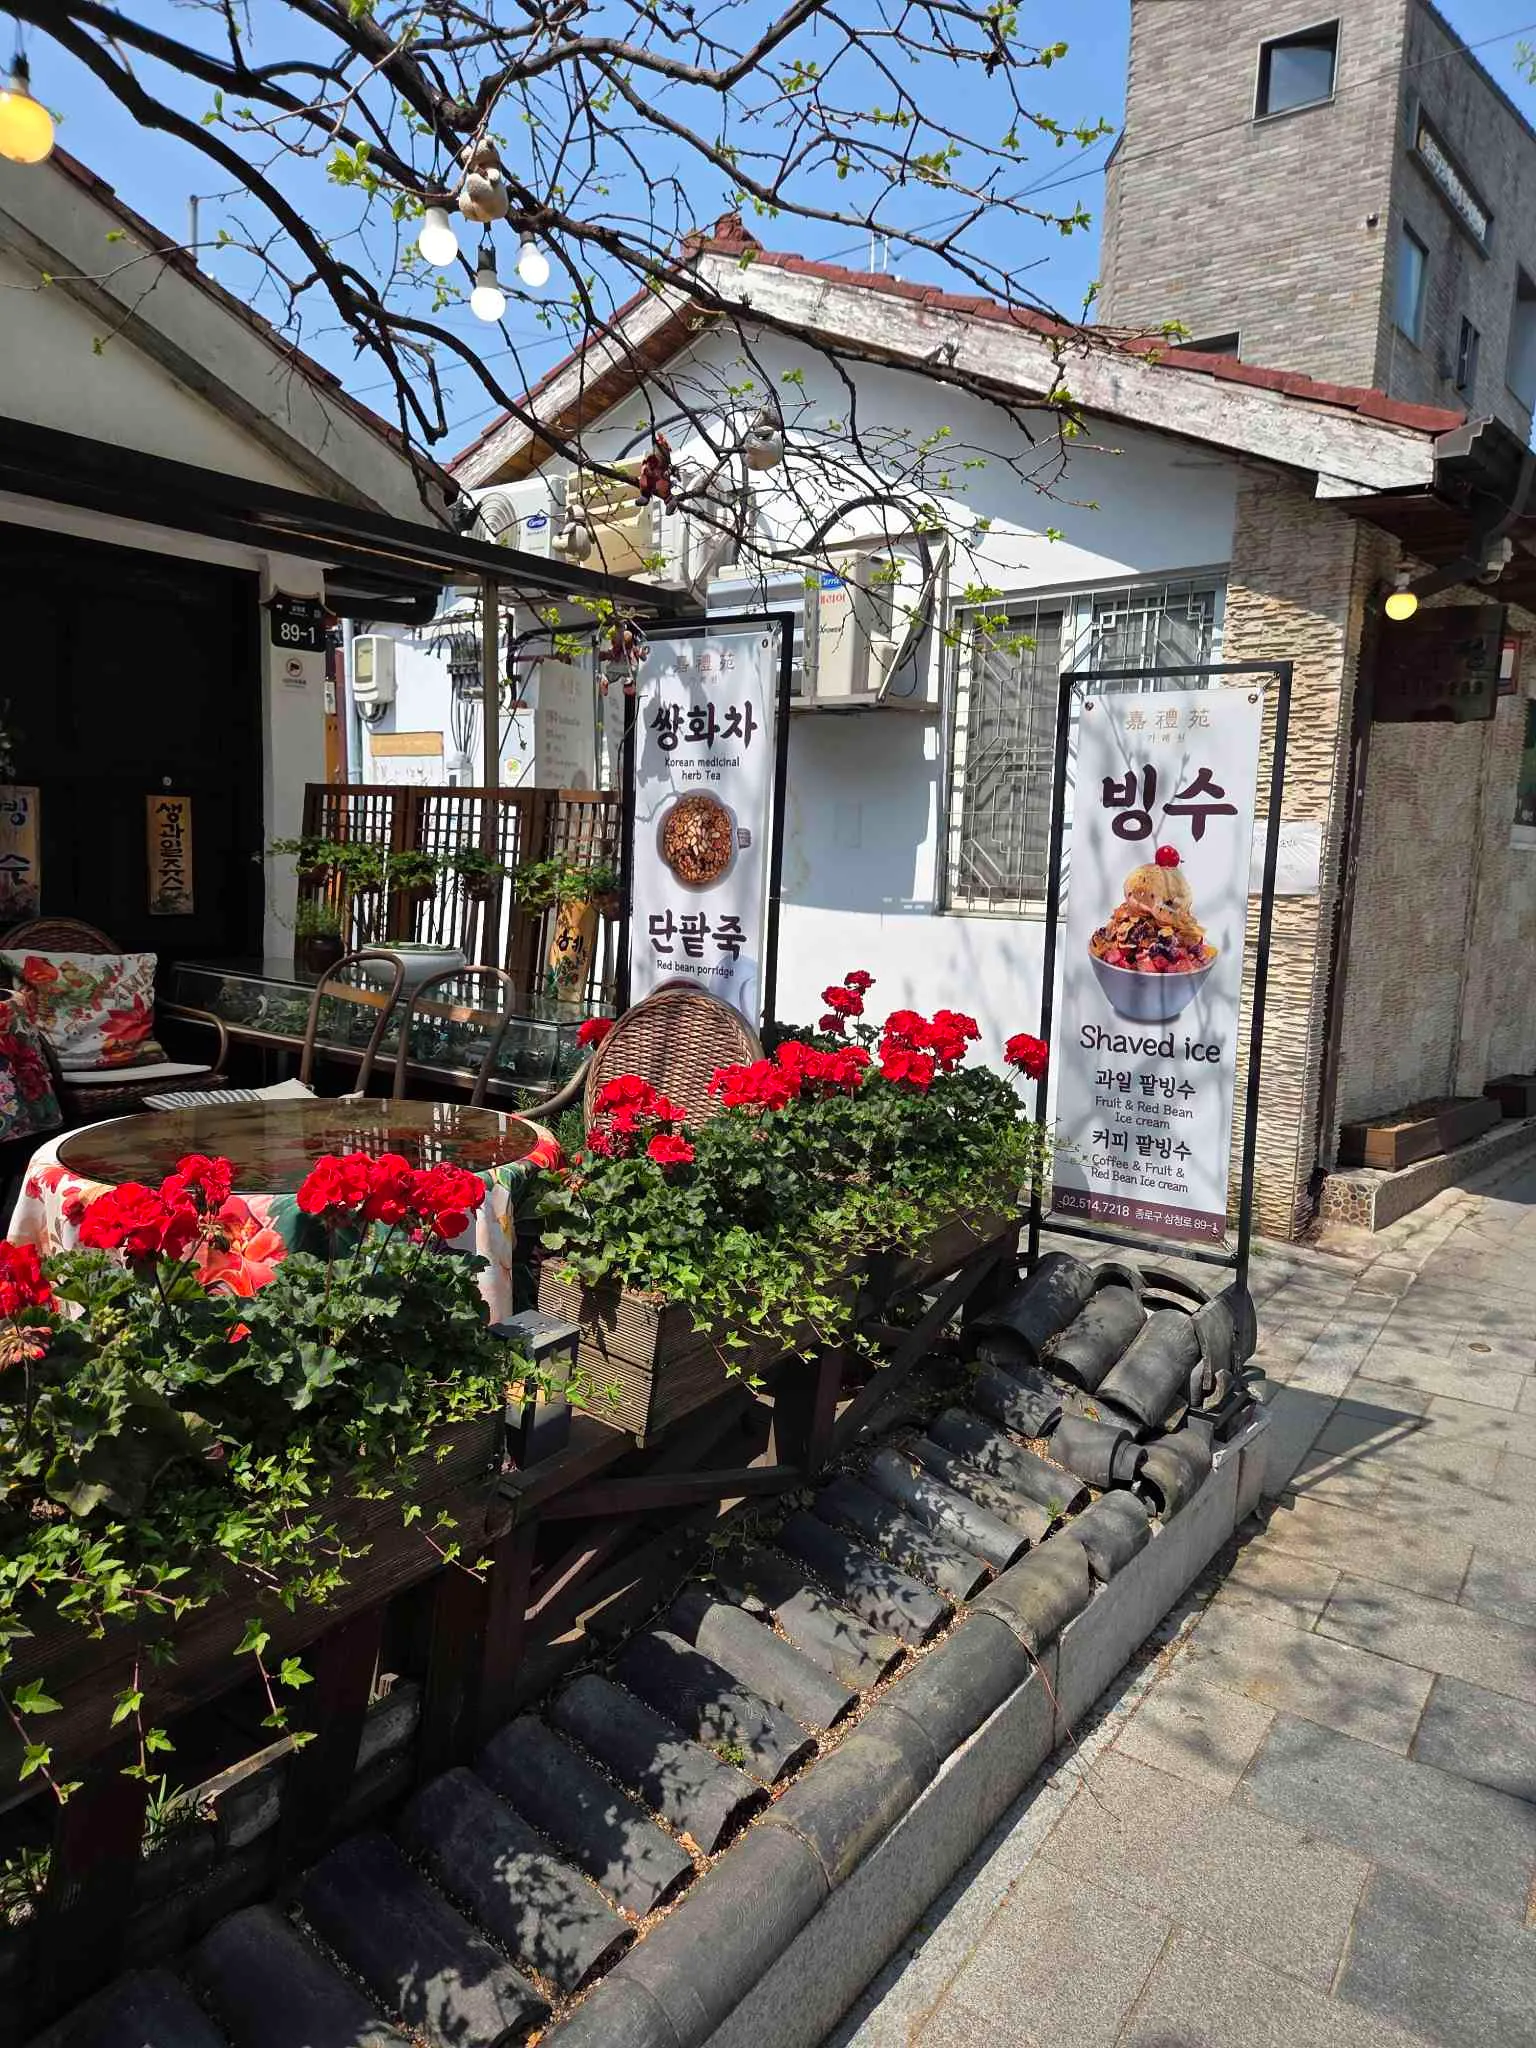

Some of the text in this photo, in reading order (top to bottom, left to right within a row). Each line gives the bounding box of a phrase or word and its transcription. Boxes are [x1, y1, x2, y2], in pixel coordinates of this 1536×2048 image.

[280, 622, 315, 644] 89-1
[650, 700, 758, 751] 쌍화차
[665, 756, 740, 768] Korean medicinal
[682, 770, 721, 781] herb Tea
[1102, 763, 1238, 842] 빙수
[648, 908, 747, 961] 단팥죽
[657, 960, 734, 979] Red bean porridge
[1080, 1024, 1221, 1064] Shaved ice
[1095, 1068, 1196, 1101] 과일 팥빙수
[1095, 1095, 1193, 1119] Fruit & Red Bean
[1115, 1111, 1171, 1129] Ice cream
[1092, 1128, 1192, 1161] 커피 팥빙수
[1091, 1153, 1185, 1179] Coffee & Fruit &
[1091, 1167, 1188, 1193] Red Bean Ice cream
[1062, 1194, 1130, 1218] 02.514.7218
